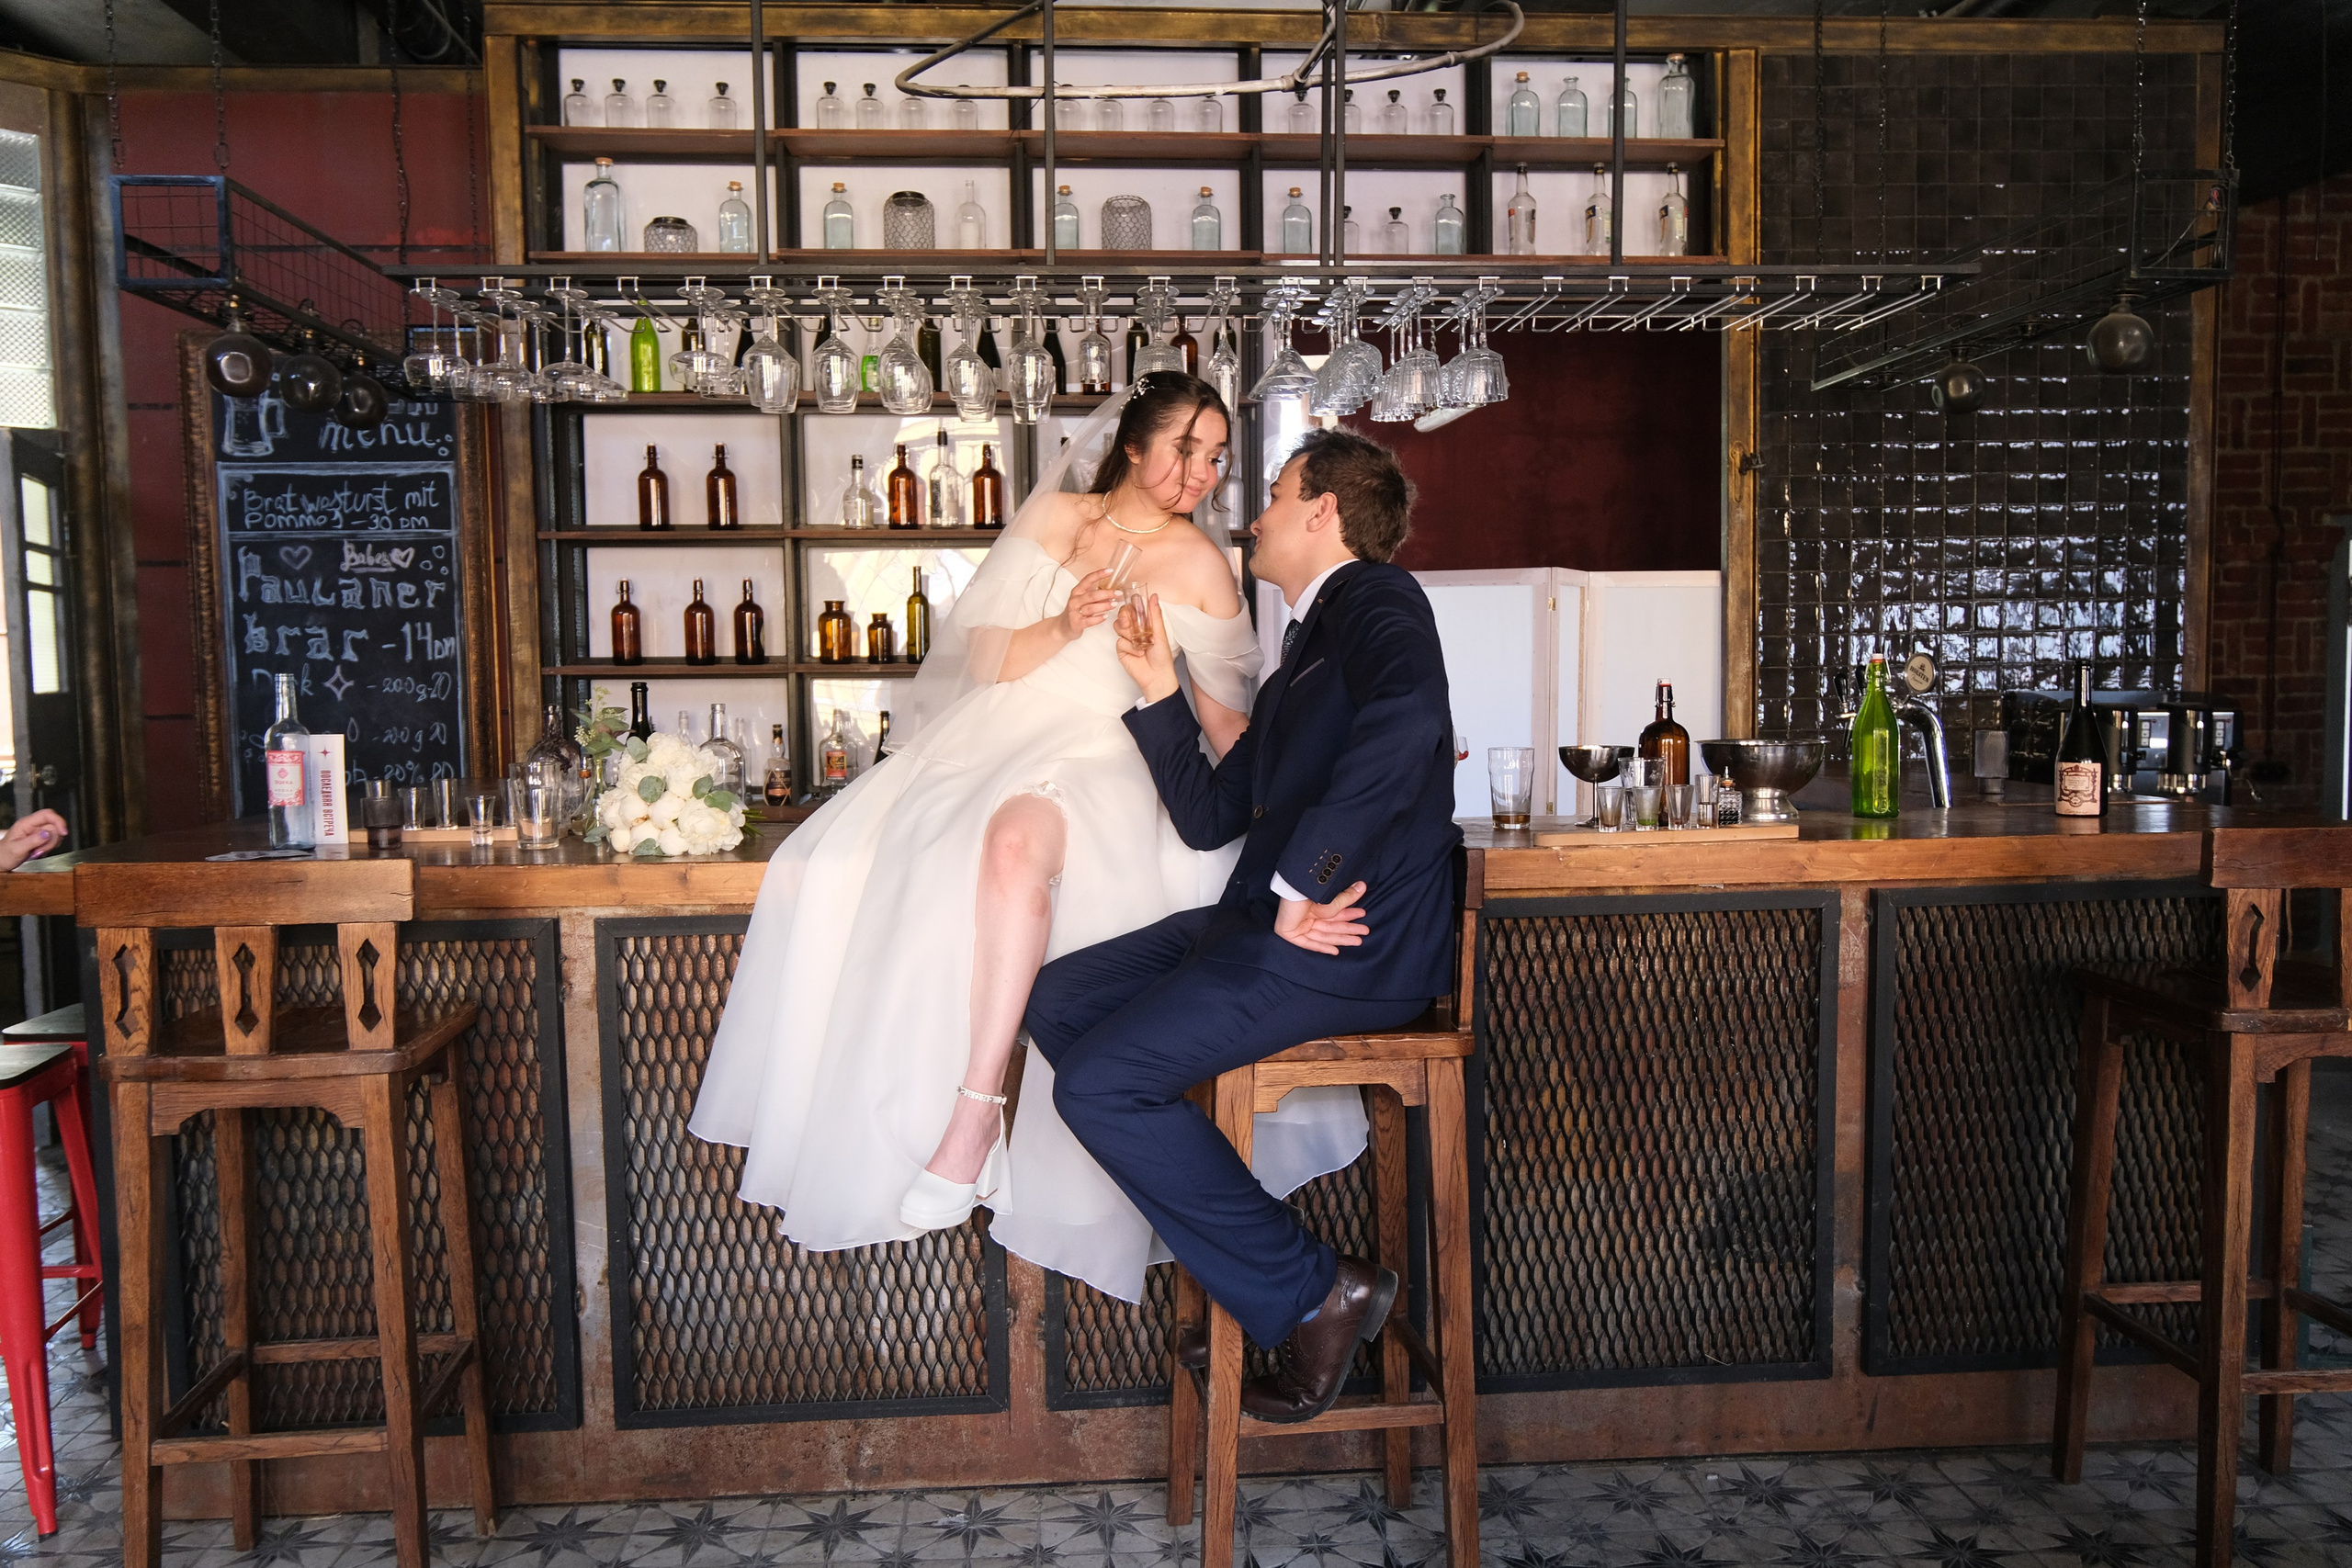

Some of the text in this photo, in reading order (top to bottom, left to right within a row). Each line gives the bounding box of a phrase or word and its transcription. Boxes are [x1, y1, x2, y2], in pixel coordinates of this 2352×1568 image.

[405, 480, 440, 510] mit
[1909, 666, 1930, 682] HOLSTEN
[321, 770, 334, 837] ПОСЛЕДНЯЯ ВСТРЕЧА
